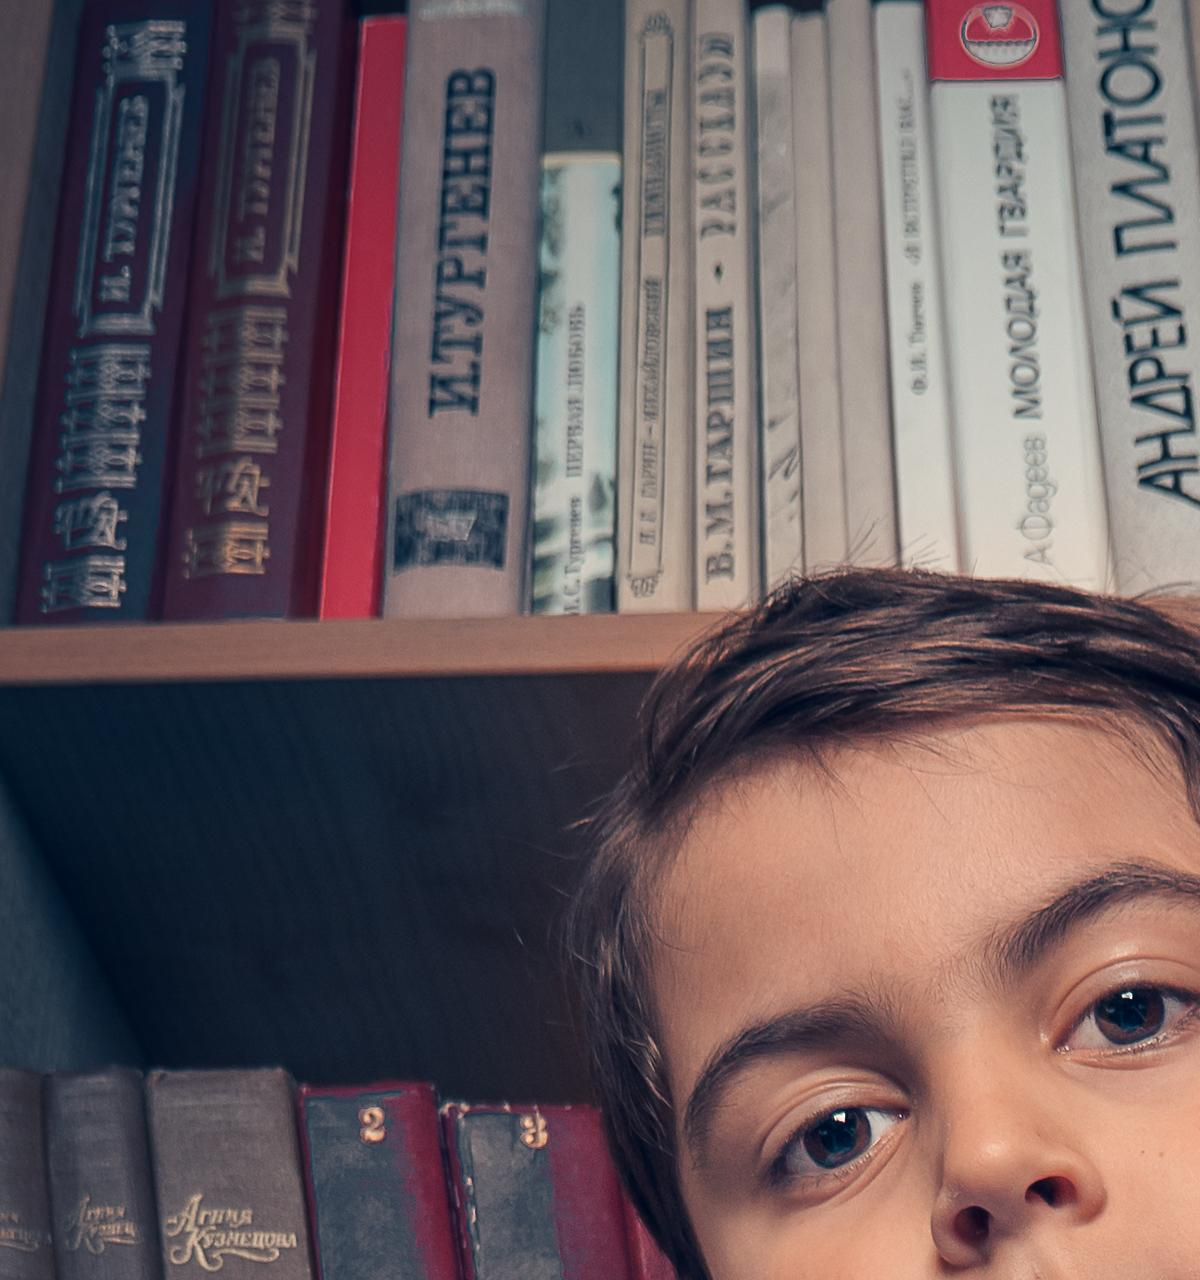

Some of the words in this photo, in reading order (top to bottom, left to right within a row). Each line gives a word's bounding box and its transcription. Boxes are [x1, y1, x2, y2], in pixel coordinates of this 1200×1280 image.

[988, 94, 1029, 239] ГВАРДИЯ
[998, 250, 1044, 421] МОЛОДАЯ
[1014, 434, 1058, 541] Фадеев
[358, 1107, 386, 1145] 2
